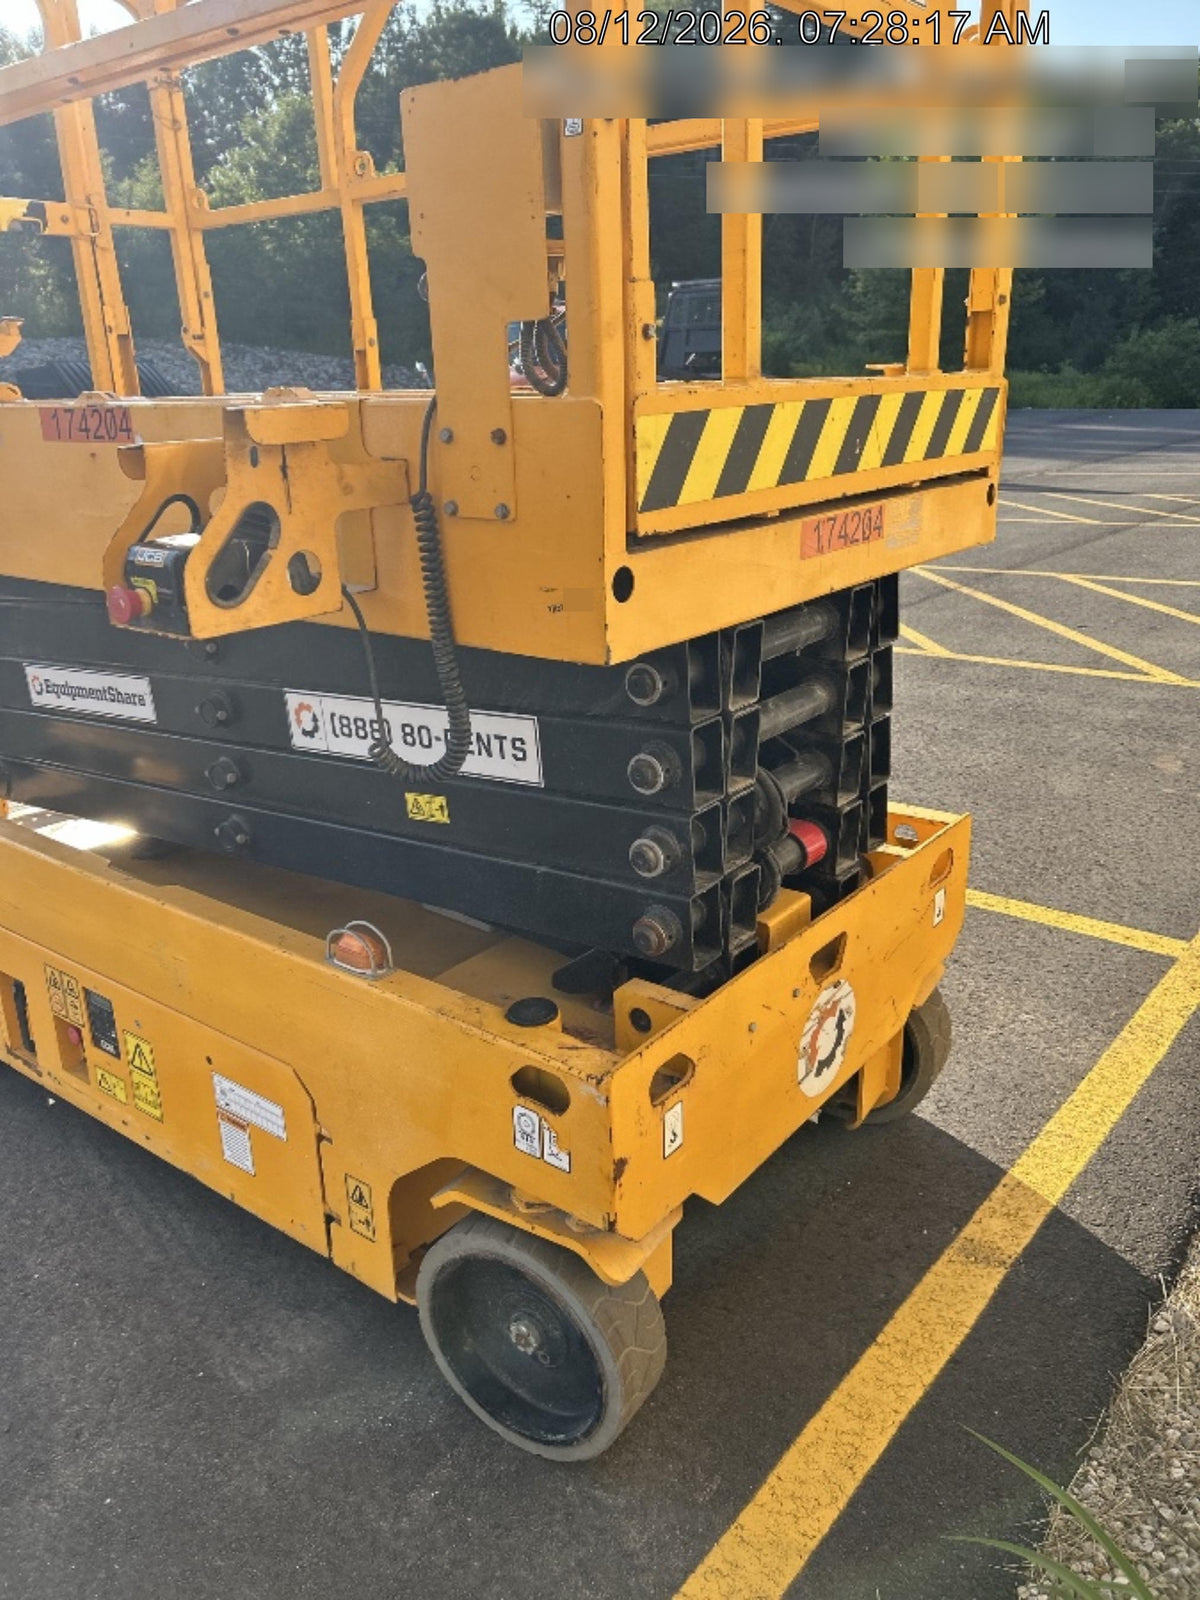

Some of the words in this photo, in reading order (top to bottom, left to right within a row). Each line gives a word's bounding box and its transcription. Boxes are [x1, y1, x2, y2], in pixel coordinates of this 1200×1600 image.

[51, 405, 132, 441] 174204
[814, 505, 883, 554] 174204
[43, 679, 146, 706] EquipmentShare
[330, 712, 392, 745] (888)
[402, 723, 528, 762] 80-NTS
